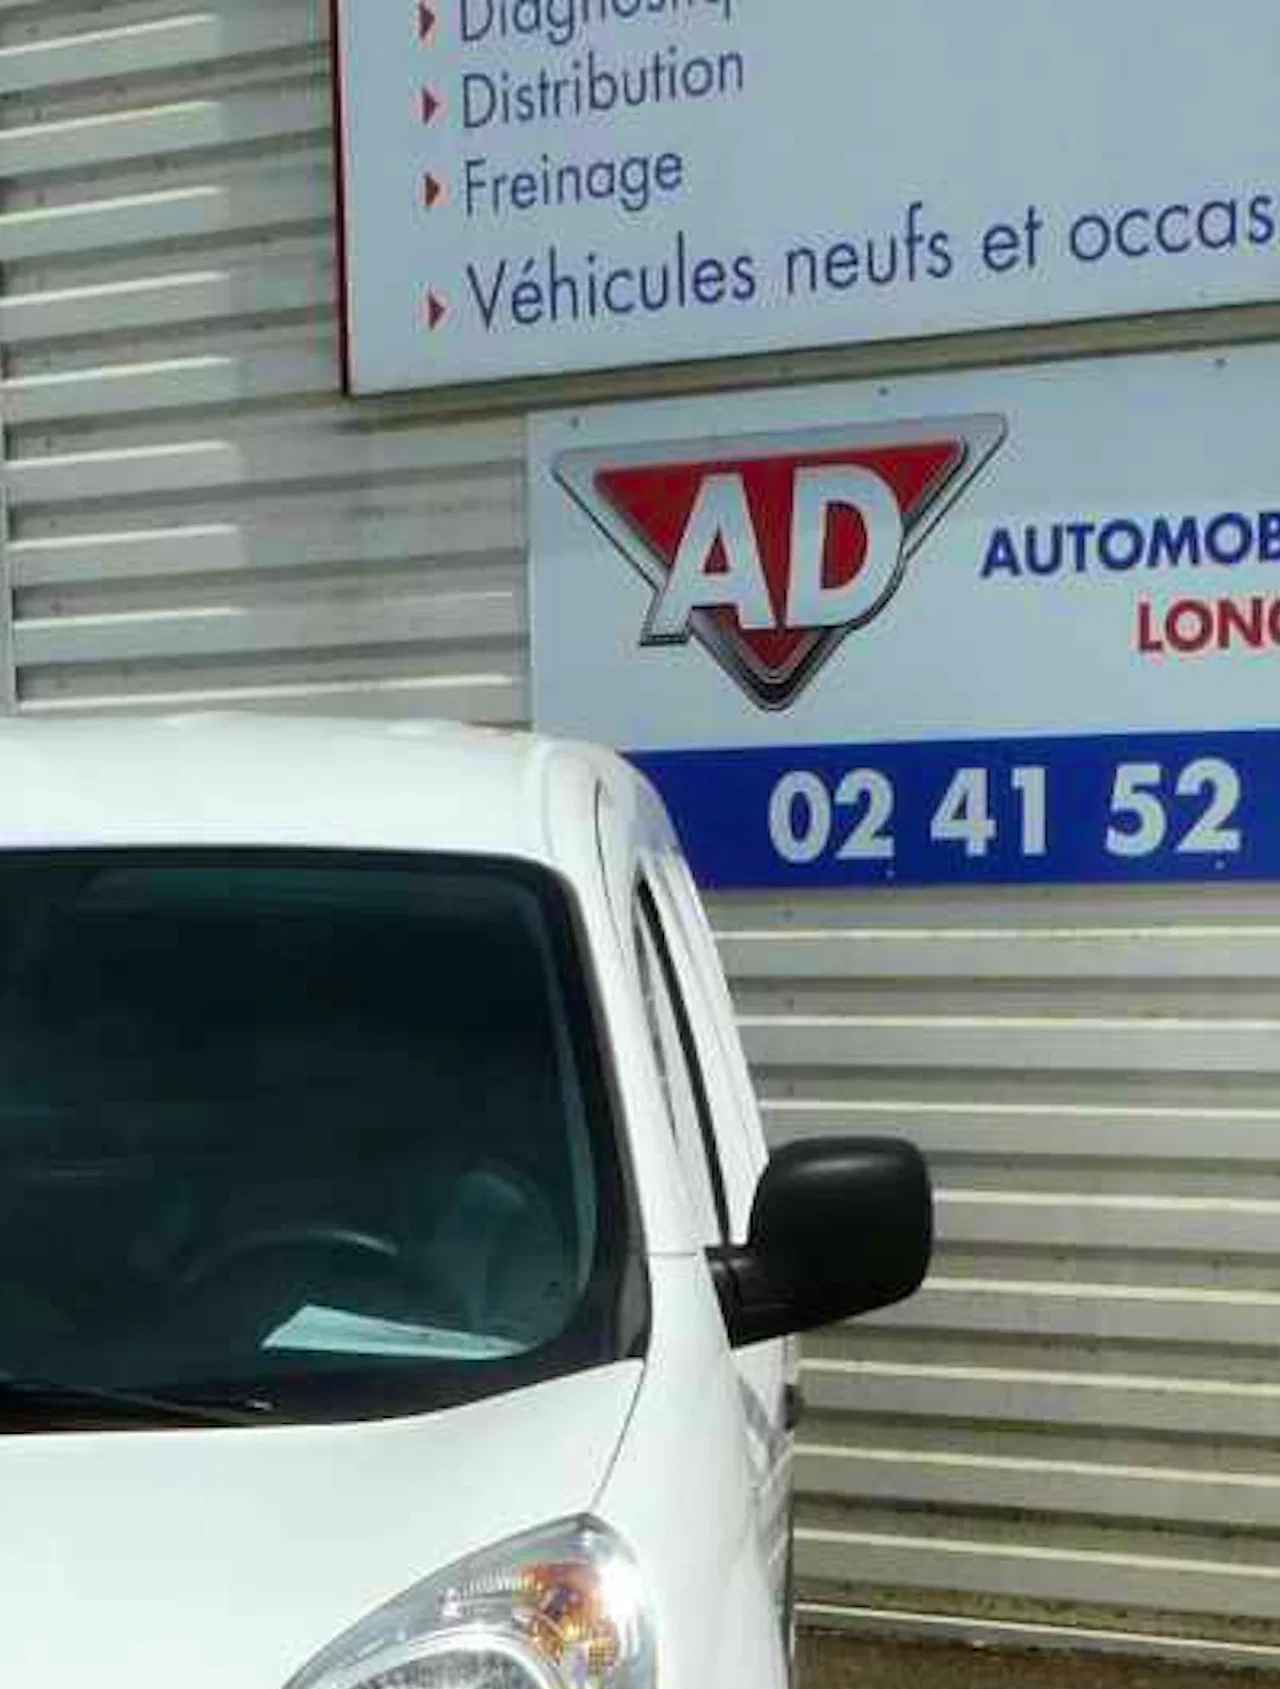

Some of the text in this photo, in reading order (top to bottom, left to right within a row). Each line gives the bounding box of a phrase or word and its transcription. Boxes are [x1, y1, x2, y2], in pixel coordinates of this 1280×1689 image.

[462, 44, 744, 129] Distribution
[463, 146, 683, 217] Freinage
[466, 230, 756, 329] Véhicules
[786, 202, 951, 296] neufs
[982, 204, 1042, 272] et
[640, 462, 906, 645] AD
[769, 770, 895, 863] 02
[931, 766, 1047, 857] 41
[1106, 758, 1242, 857] 52
